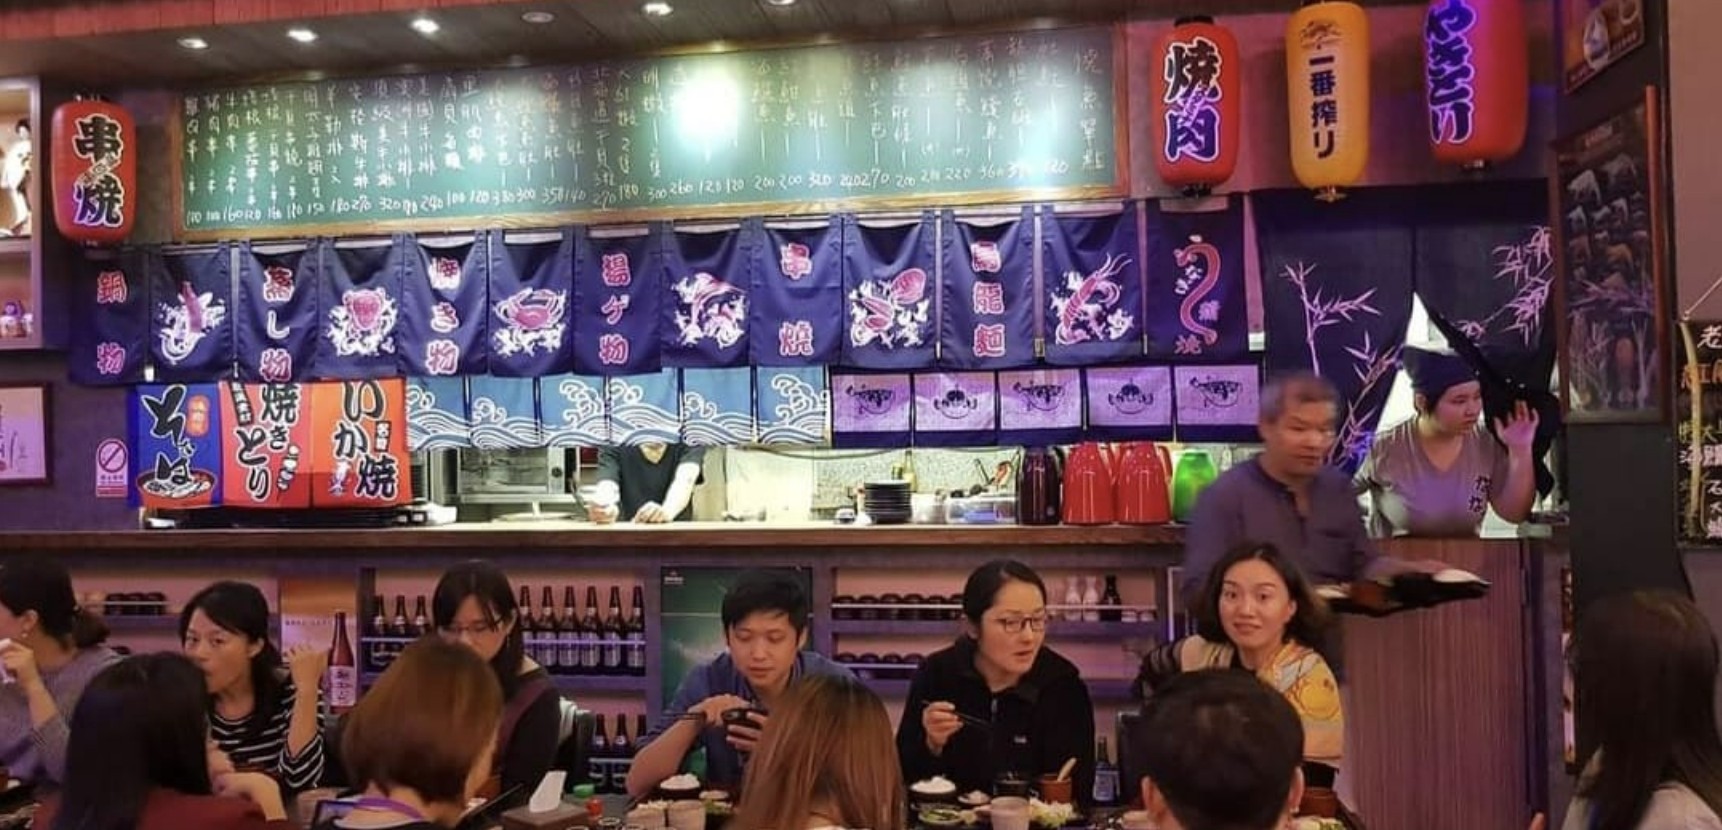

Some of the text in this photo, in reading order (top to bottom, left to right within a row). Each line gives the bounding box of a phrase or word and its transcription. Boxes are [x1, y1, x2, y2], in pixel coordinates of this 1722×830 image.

[1309, 55, 1337, 158] 一番搾り
[1425, 0, 1476, 144] やきとり
